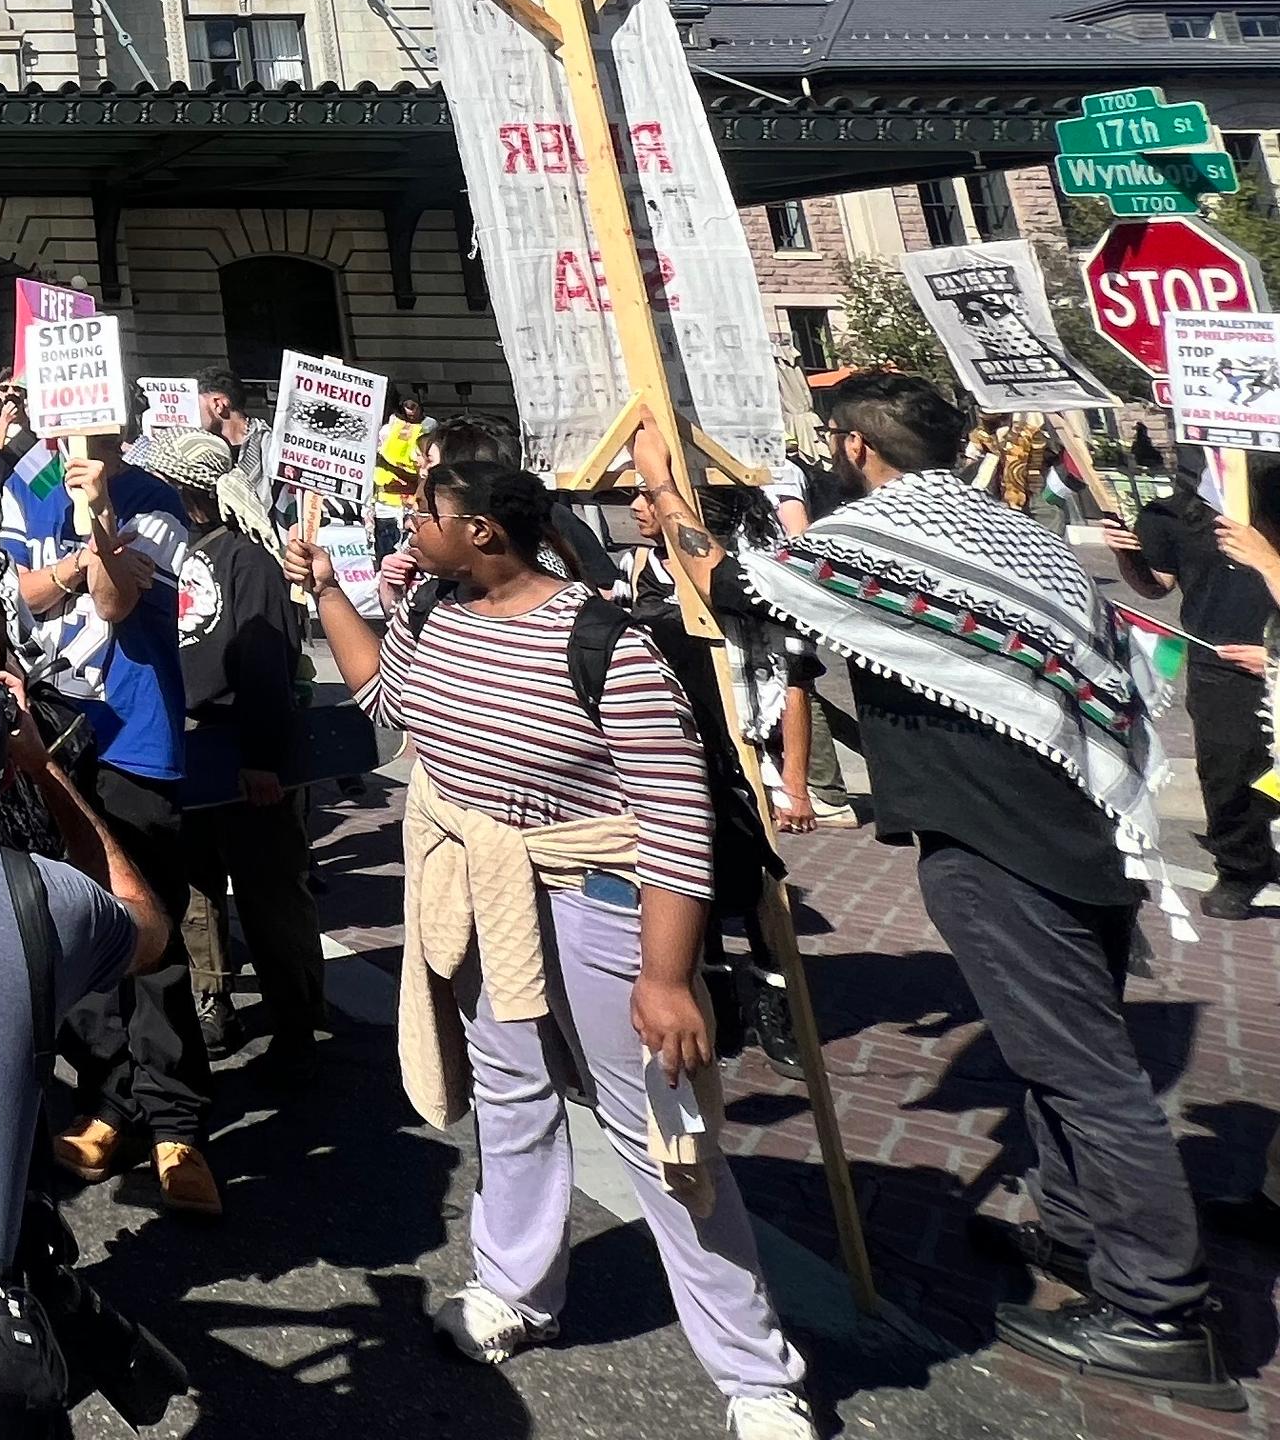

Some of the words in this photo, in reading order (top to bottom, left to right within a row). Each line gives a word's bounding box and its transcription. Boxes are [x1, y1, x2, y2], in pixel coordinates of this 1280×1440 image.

[1098, 93, 1137, 112] 1700
[1096, 116, 1161, 149] 17th
[1173, 117, 1195, 133] St
[1067, 158, 1198, 189] Wynkoop
[1206, 164, 1228, 180] St
[1131, 196, 1177, 212] 1700
[932, 269, 1008, 291] DIVEST
[40, 287, 74, 321] FREE
[1099, 267, 1239, 328] STOP
[1175, 318, 1207, 328] FROM
[1209, 319, 1274, 330] PALESTINE
[39, 321, 102, 347] STOP
[1176, 331, 1188, 339] TO
[1195, 331, 1275, 342] PHILIPPINES
[41, 345, 103, 362] BOMBING
[1178, 346, 1215, 358] STOP
[40, 360, 108, 384] RAFAH
[297, 360, 323, 375] FROM
[325, 365, 375, 389] PALESTINE
[1182, 364, 1211, 377] THE
[41, 382, 109, 409] NOW!
[146, 382, 167, 392] END
[169, 383, 190, 393] U.S.
[295, 375, 313, 392] TO
[316, 381, 371, 408] MEXICO
[1184, 384, 1212, 397] U.S.
[160, 393, 179, 404] AID
[155, 413, 189, 424] ISRAEL
[164, 405, 176, 414] TO
[1181, 410, 1211, 420] WAR
[283, 432, 327, 454] BORDER
[330, 445, 366, 465] WALLS
[281, 448, 309, 465] HAVE
[311, 457, 331, 471] GOT
[334, 465, 347, 475] TO
[348, 468, 364, 480] GO
